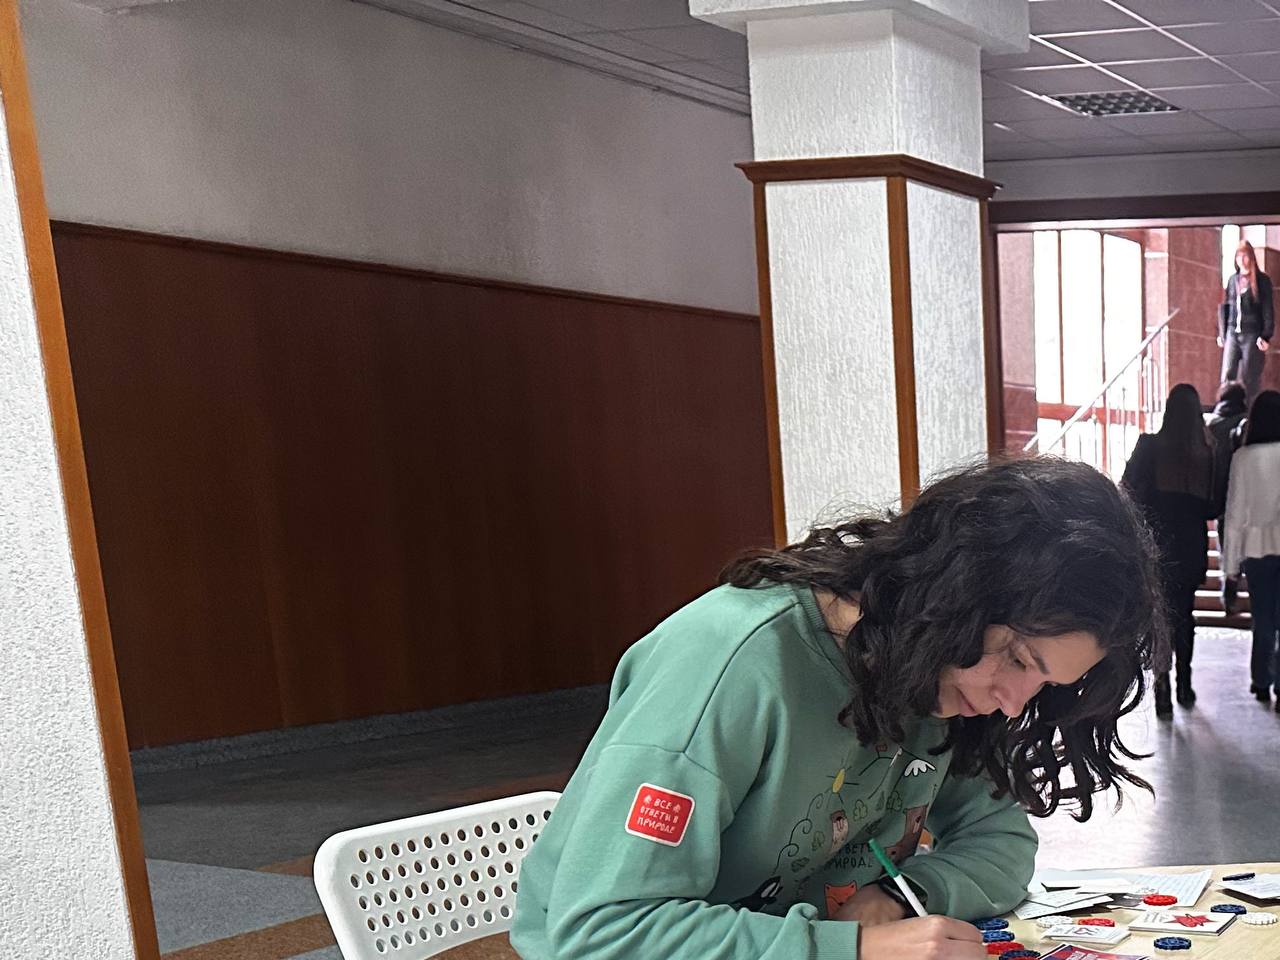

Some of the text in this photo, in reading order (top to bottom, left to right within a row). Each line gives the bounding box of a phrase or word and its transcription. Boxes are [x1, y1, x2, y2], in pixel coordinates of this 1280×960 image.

[653, 798, 673, 810] ВСЕ
[640, 805, 679, 824] ОТВЕТЫ В
[636, 816, 676, 834] ПРИРОДЕ
